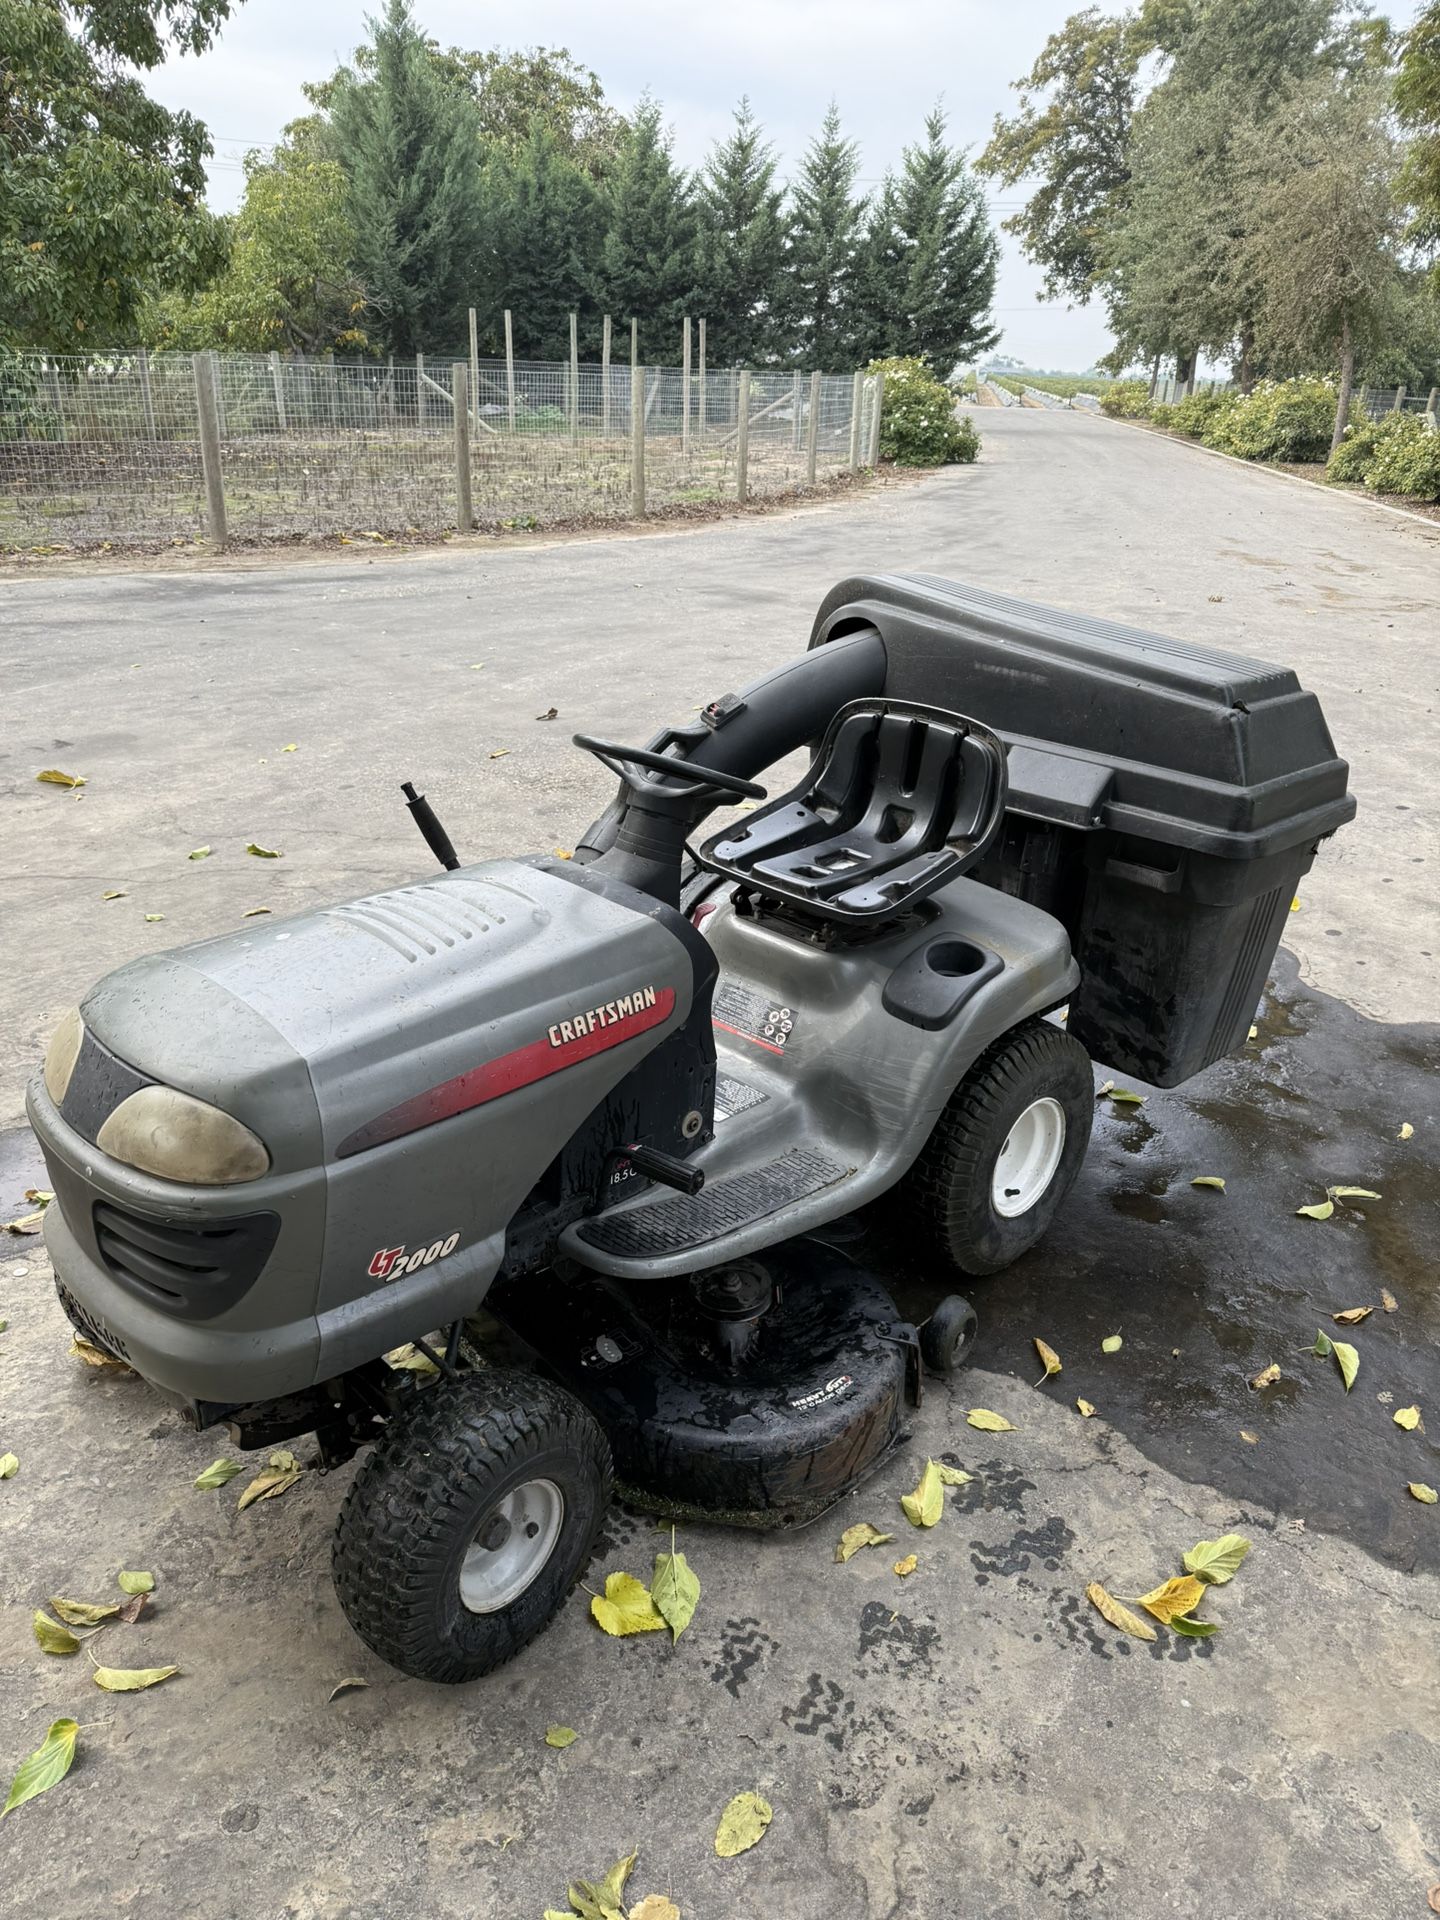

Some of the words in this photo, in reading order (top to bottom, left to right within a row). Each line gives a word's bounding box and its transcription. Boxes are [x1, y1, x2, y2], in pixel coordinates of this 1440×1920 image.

[548, 985, 656, 1047] CRAFTSMAN
[368, 1231, 460, 1283] LT2000
[792, 1390, 825, 1407] HEAVY
